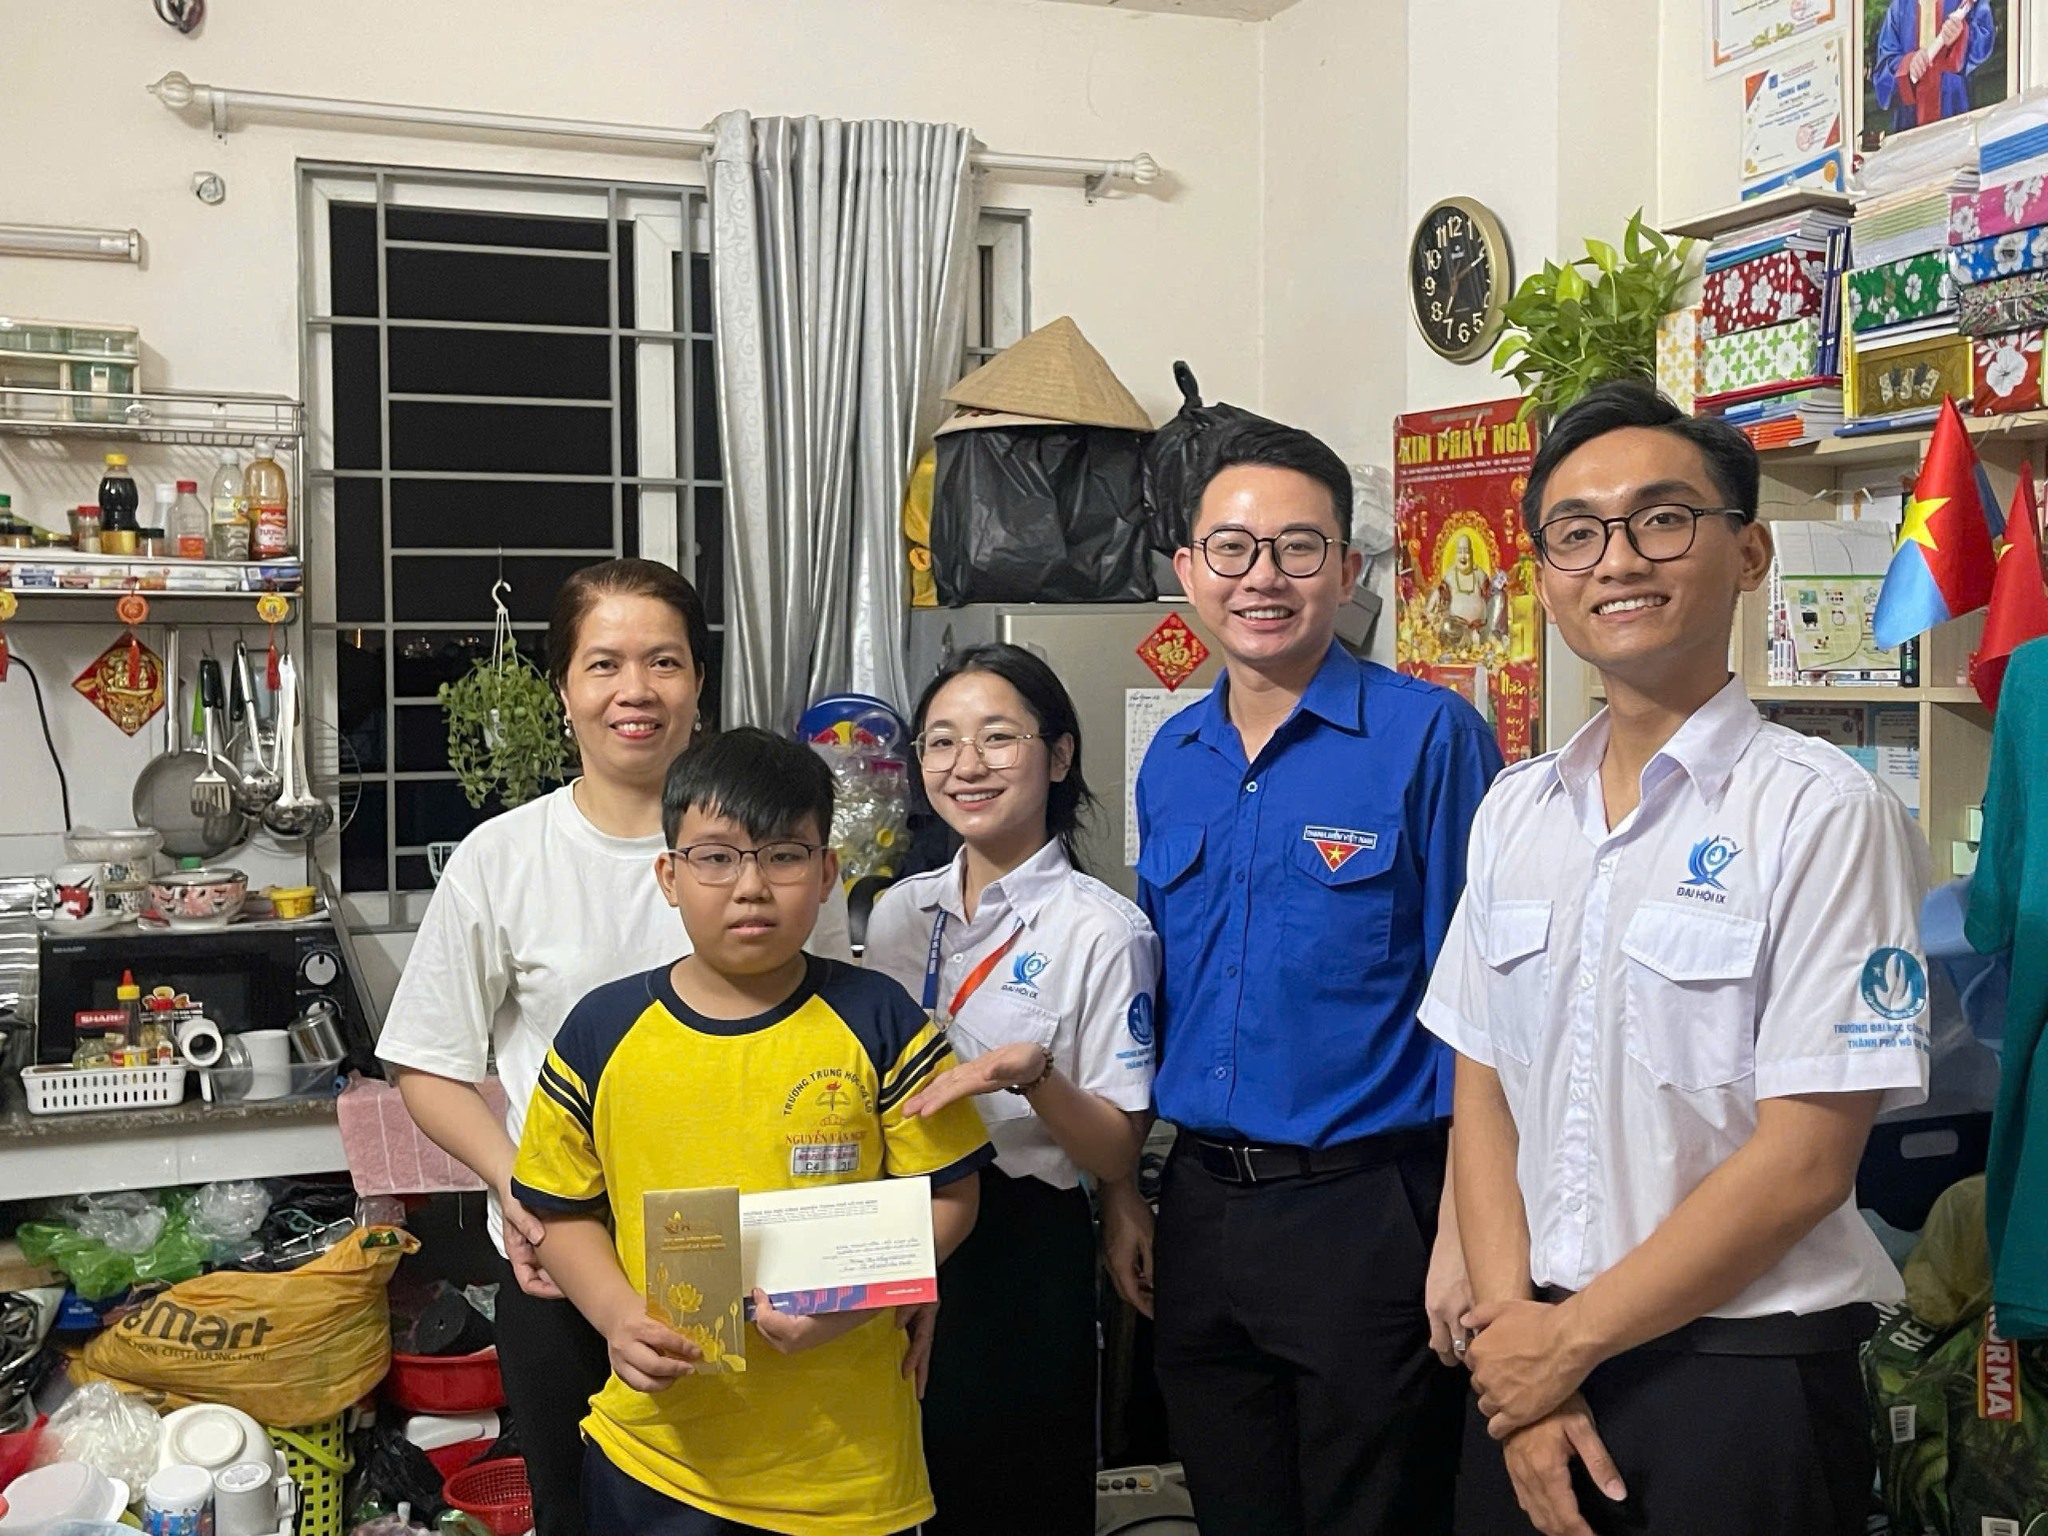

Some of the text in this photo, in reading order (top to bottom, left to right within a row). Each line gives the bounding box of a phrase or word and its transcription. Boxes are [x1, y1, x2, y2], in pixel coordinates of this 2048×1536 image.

[1436, 224, 1447, 248] 11
[1447, 215, 1462, 238] 12
[1467, 216, 1474, 240] 1
[1424, 249, 1442, 270] 10
[1424, 276, 1437, 296] 9
[1431, 301, 1443, 322] 8
[1442, 317, 1454, 340] 7
[1458, 322, 1471, 343] 6
[1472, 312, 1485, 333] 5
[1676, 886, 1726, 904] ĐẠI HỘI IX
[809, 1068, 843, 1082] TRUNG
